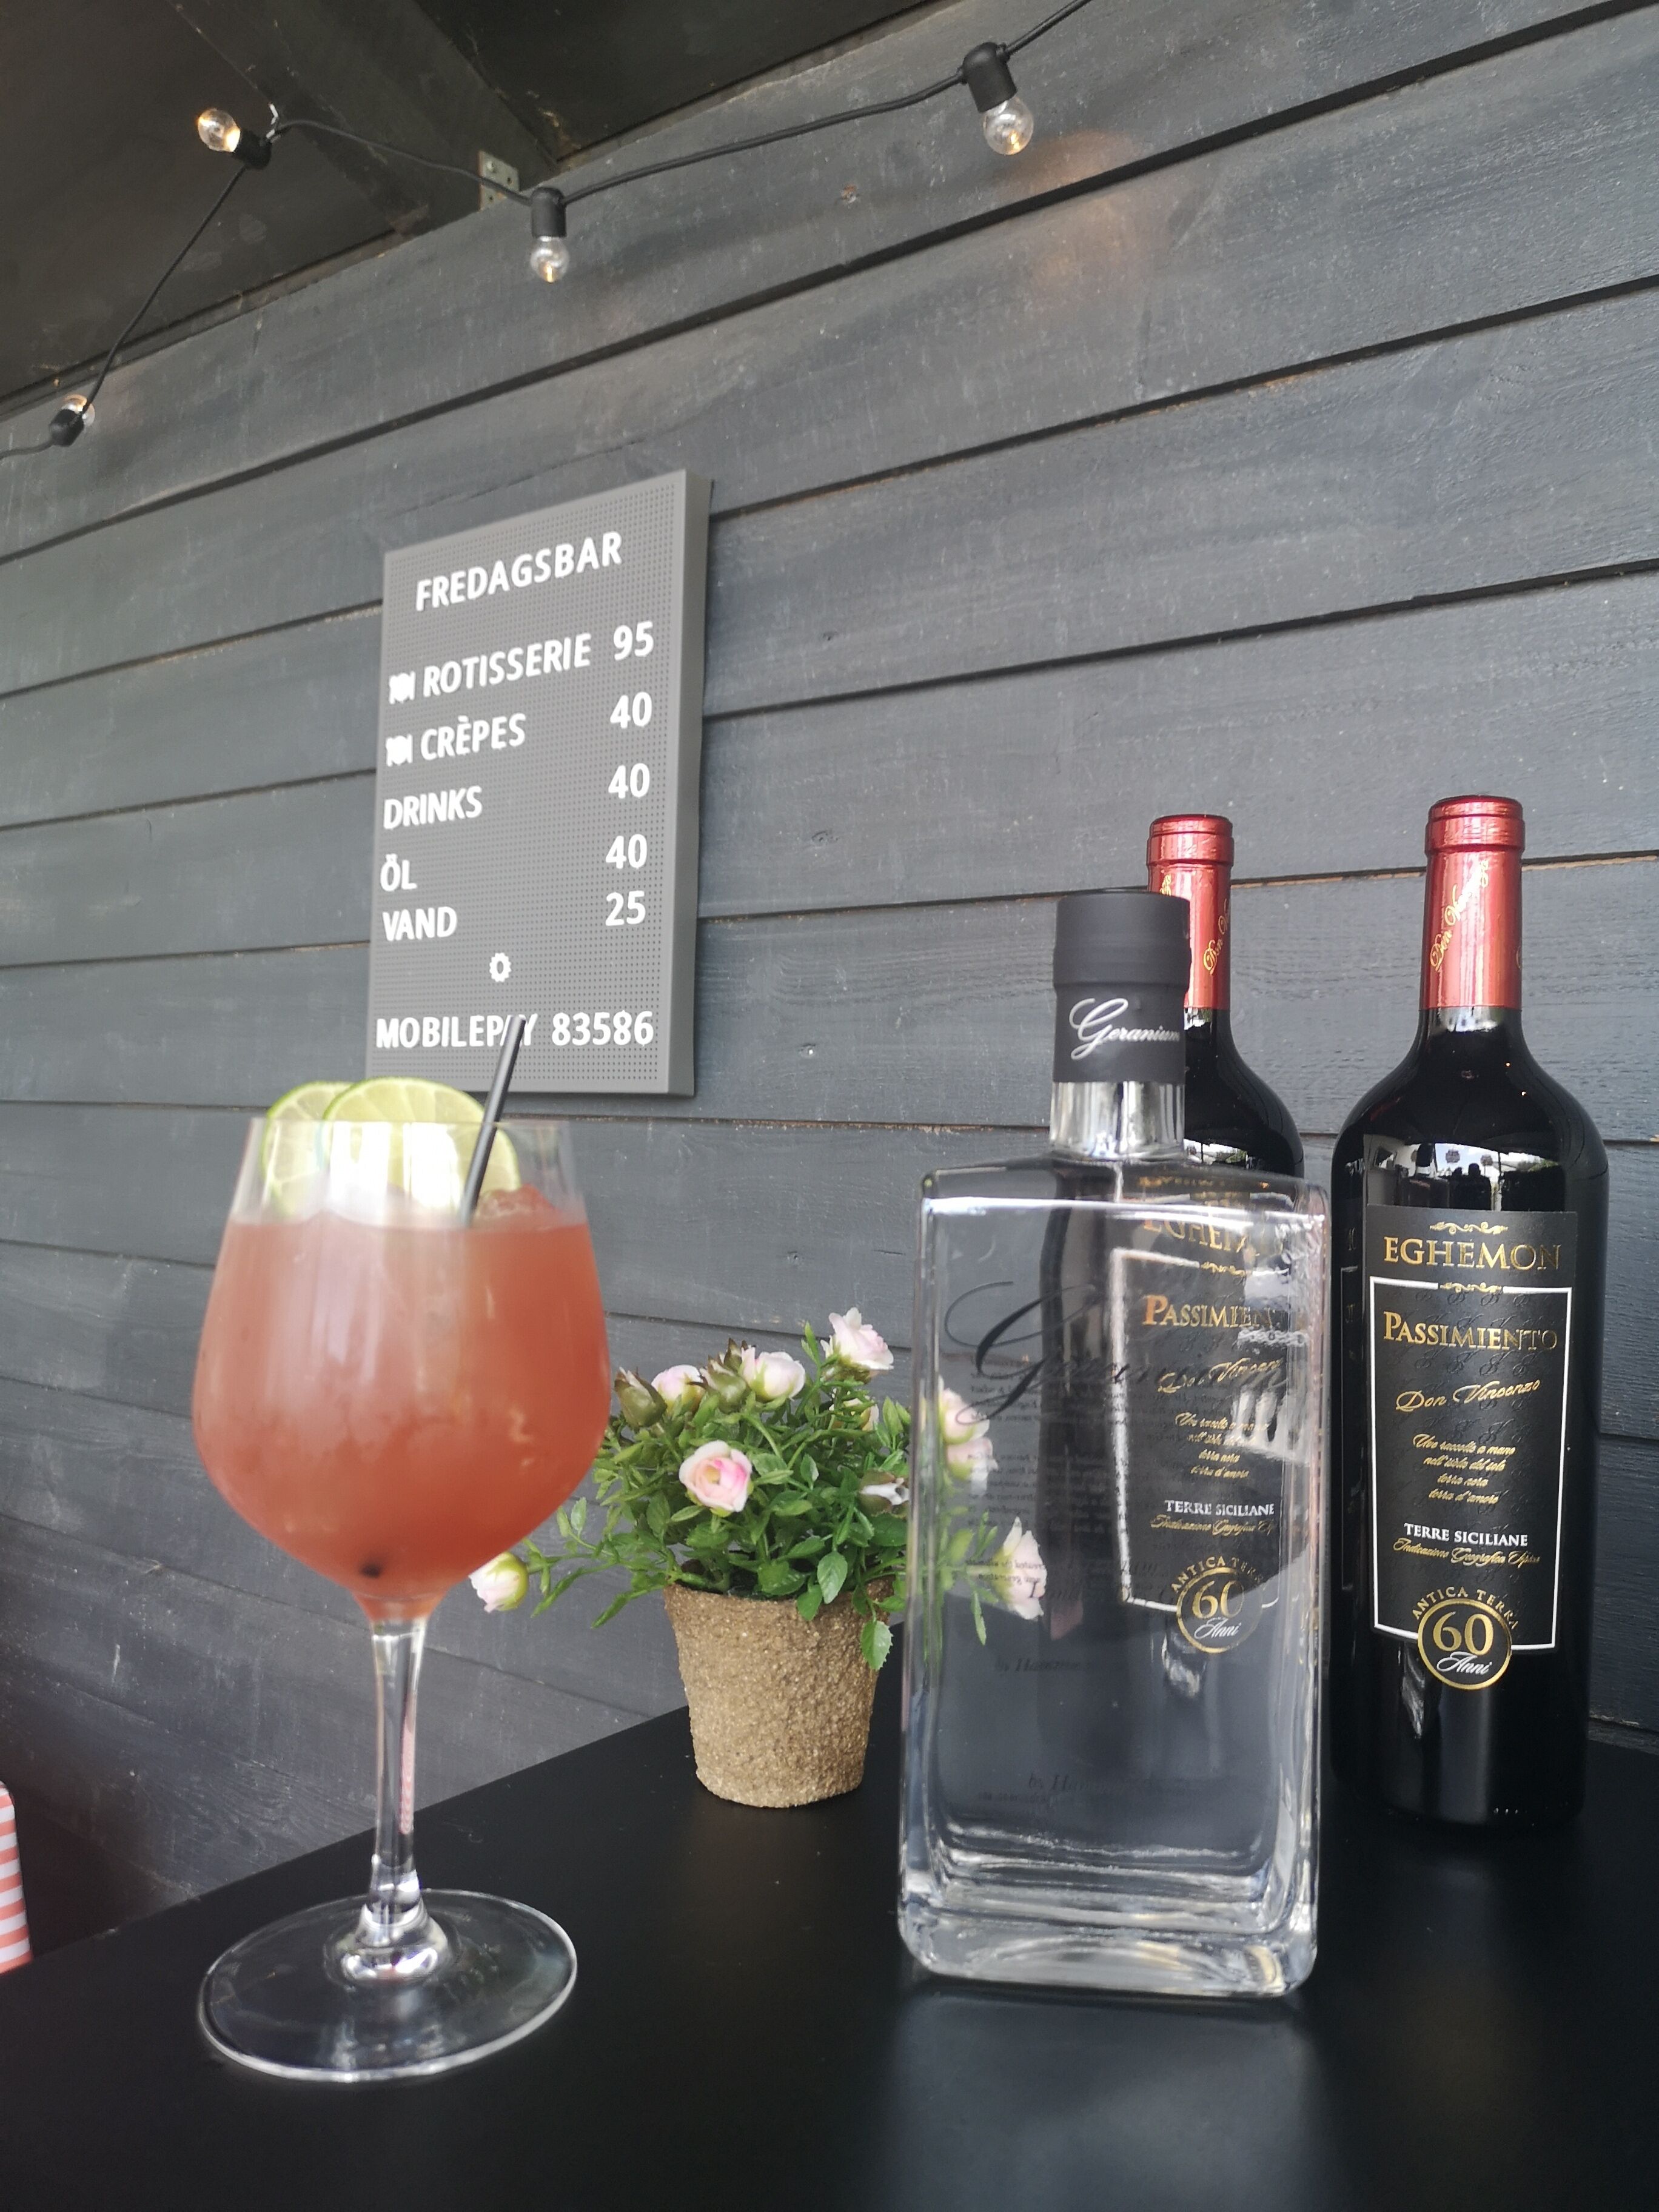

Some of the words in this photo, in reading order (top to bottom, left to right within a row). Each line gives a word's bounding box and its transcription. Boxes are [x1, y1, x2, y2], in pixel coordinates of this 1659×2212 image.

[415, 531, 622, 611] FREDAGSBAR
[423, 632, 591, 697] ROTISSERIE
[613, 620, 654, 661] 95
[420, 712, 526, 761] CRÈPES
[609, 691, 652, 729] 40
[383, 785, 483, 830] DRINKS
[608, 762, 650, 799] 40
[605, 833, 648, 870] 40
[382, 906, 458, 942] VAND
[605, 890, 646, 927] 25
[551, 1009, 654, 1047] 83586
[1069, 998, 1180, 1061] Geranium
[1383, 1236, 1562, 1271] EGHEMON
[1142, 1294, 1275, 1329] PASSIMIEN
[1382, 1311, 1558, 1350] PASSIMIENTO
[1395, 1390, 1447, 1412] Don
[1452, 1379, 1541, 1404] Vincenzo
[1164, 1500, 1212, 1515] TERRE
[1215, 1503, 1275, 1517] SICILIANE
[1404, 1523, 1450, 1541] TERRE
[1454, 1530, 1529, 1547] SICILIANE
[1170, 1556, 1225, 1594] ANTICA
[1232, 1557, 1264, 1583] TERR
[1191, 1580, 1244, 1620] 60
[1412, 1586, 1469, 1620] ANTICA
[1476, 1589, 1518, 1631] TERRA
[1193, 1616, 1242, 1640] Anni
[1432, 1611, 1494, 1656] 60
[1436, 1651, 1493, 1675] Anni
